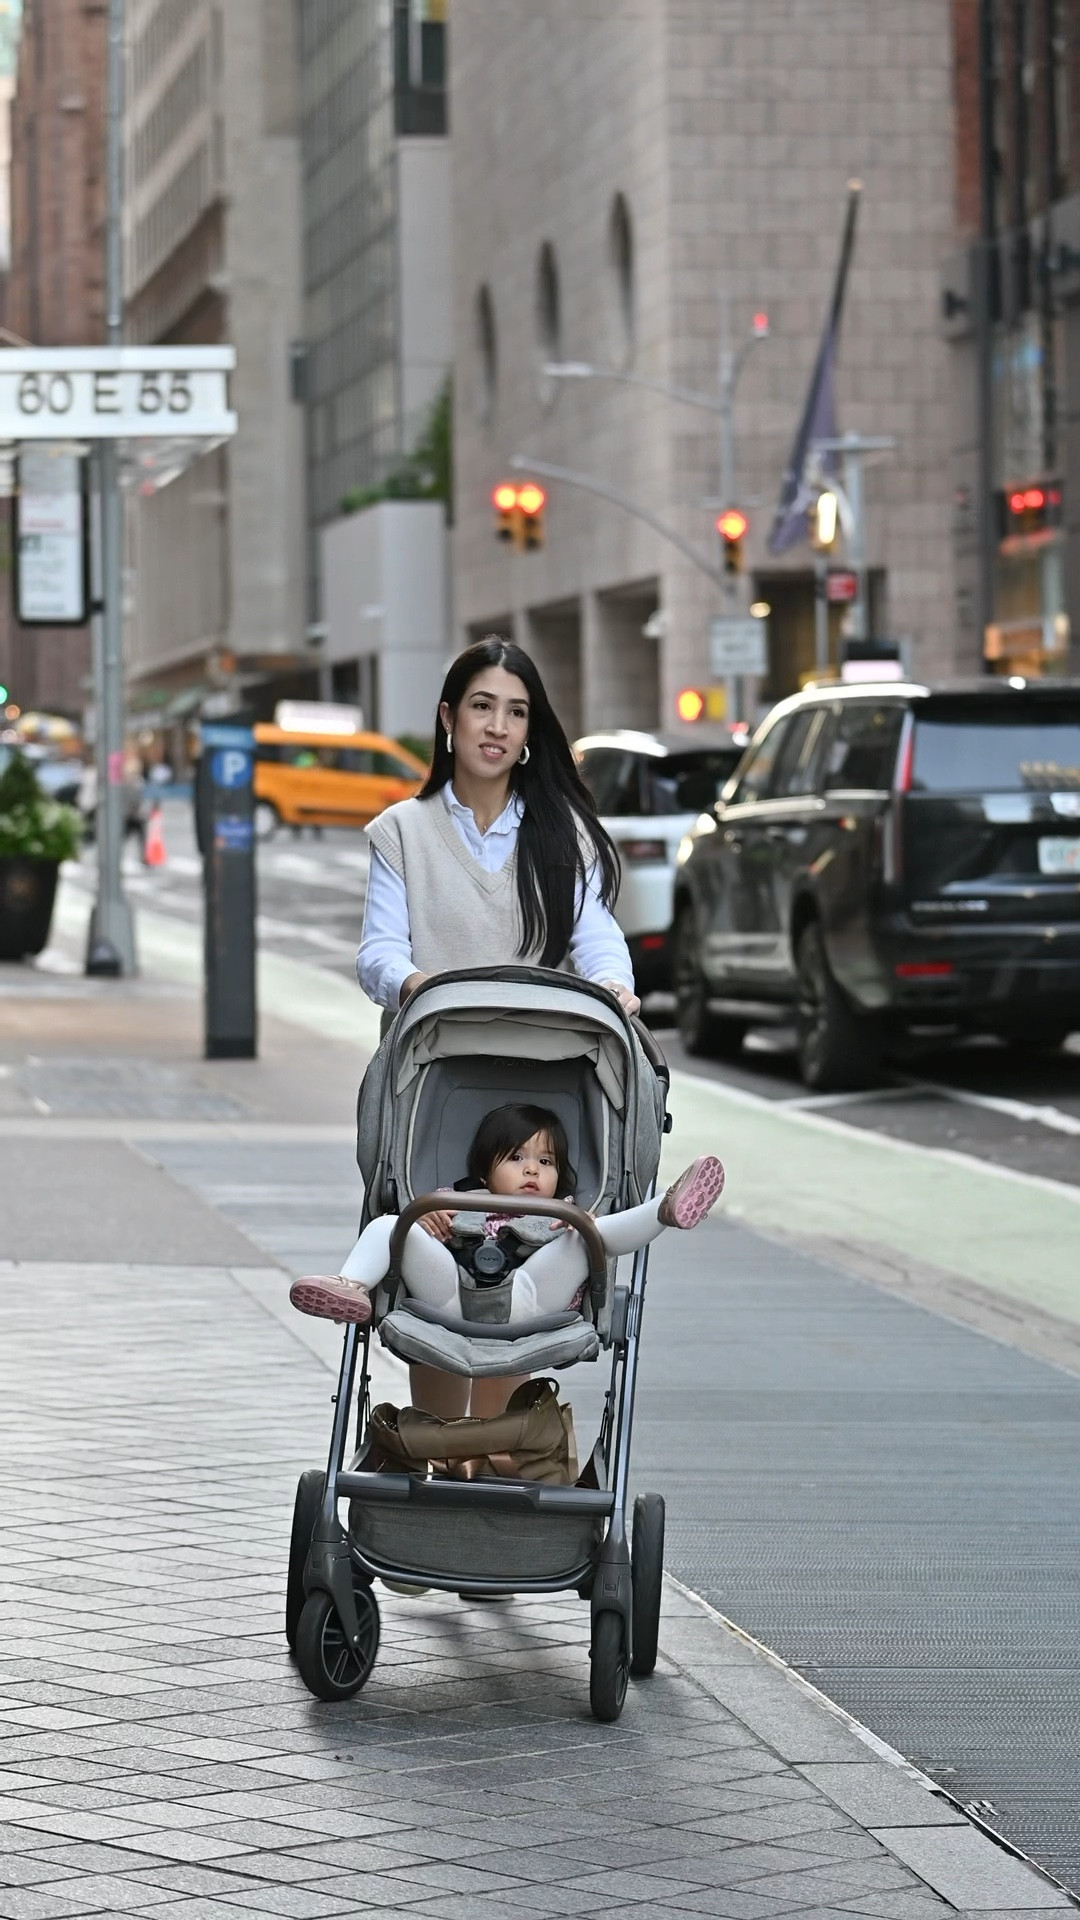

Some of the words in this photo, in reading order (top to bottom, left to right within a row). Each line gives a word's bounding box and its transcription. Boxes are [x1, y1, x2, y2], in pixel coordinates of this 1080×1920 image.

[18, 371, 73, 415] 60
[93, 371, 121, 414] E
[137, 371, 192, 415] 55
[222, 750, 247, 786] P
